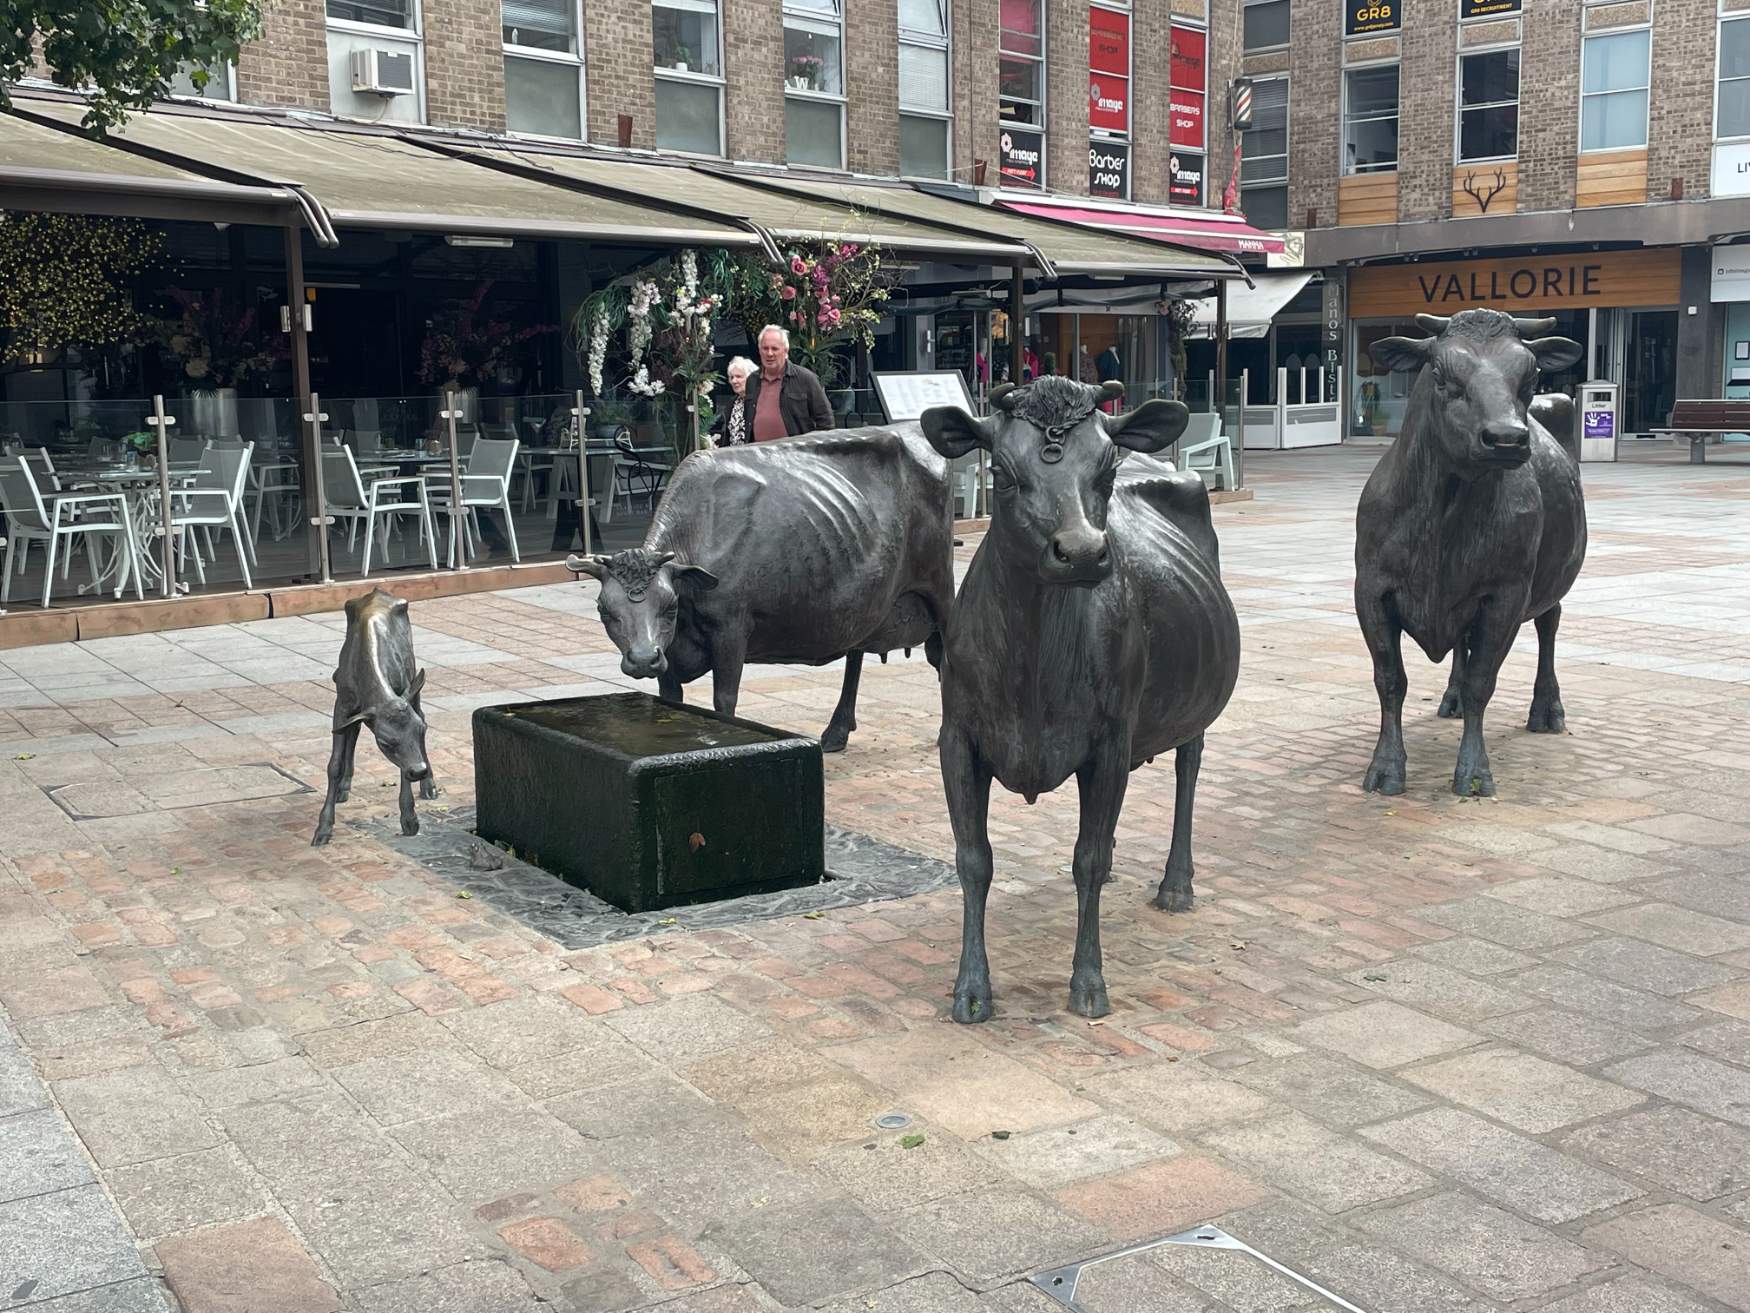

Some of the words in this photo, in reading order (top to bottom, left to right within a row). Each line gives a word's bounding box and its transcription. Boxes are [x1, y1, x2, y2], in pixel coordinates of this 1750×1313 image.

[1356, 5, 1392, 21] GR8
[1169, 103, 1201, 116] BARBERS
[1176, 119, 1194, 128] SHOP
[1737, 161, 1750, 173] LI
[1418, 265, 1602, 303] VALLORIE
[1327, 349, 1339, 403] Bistr
